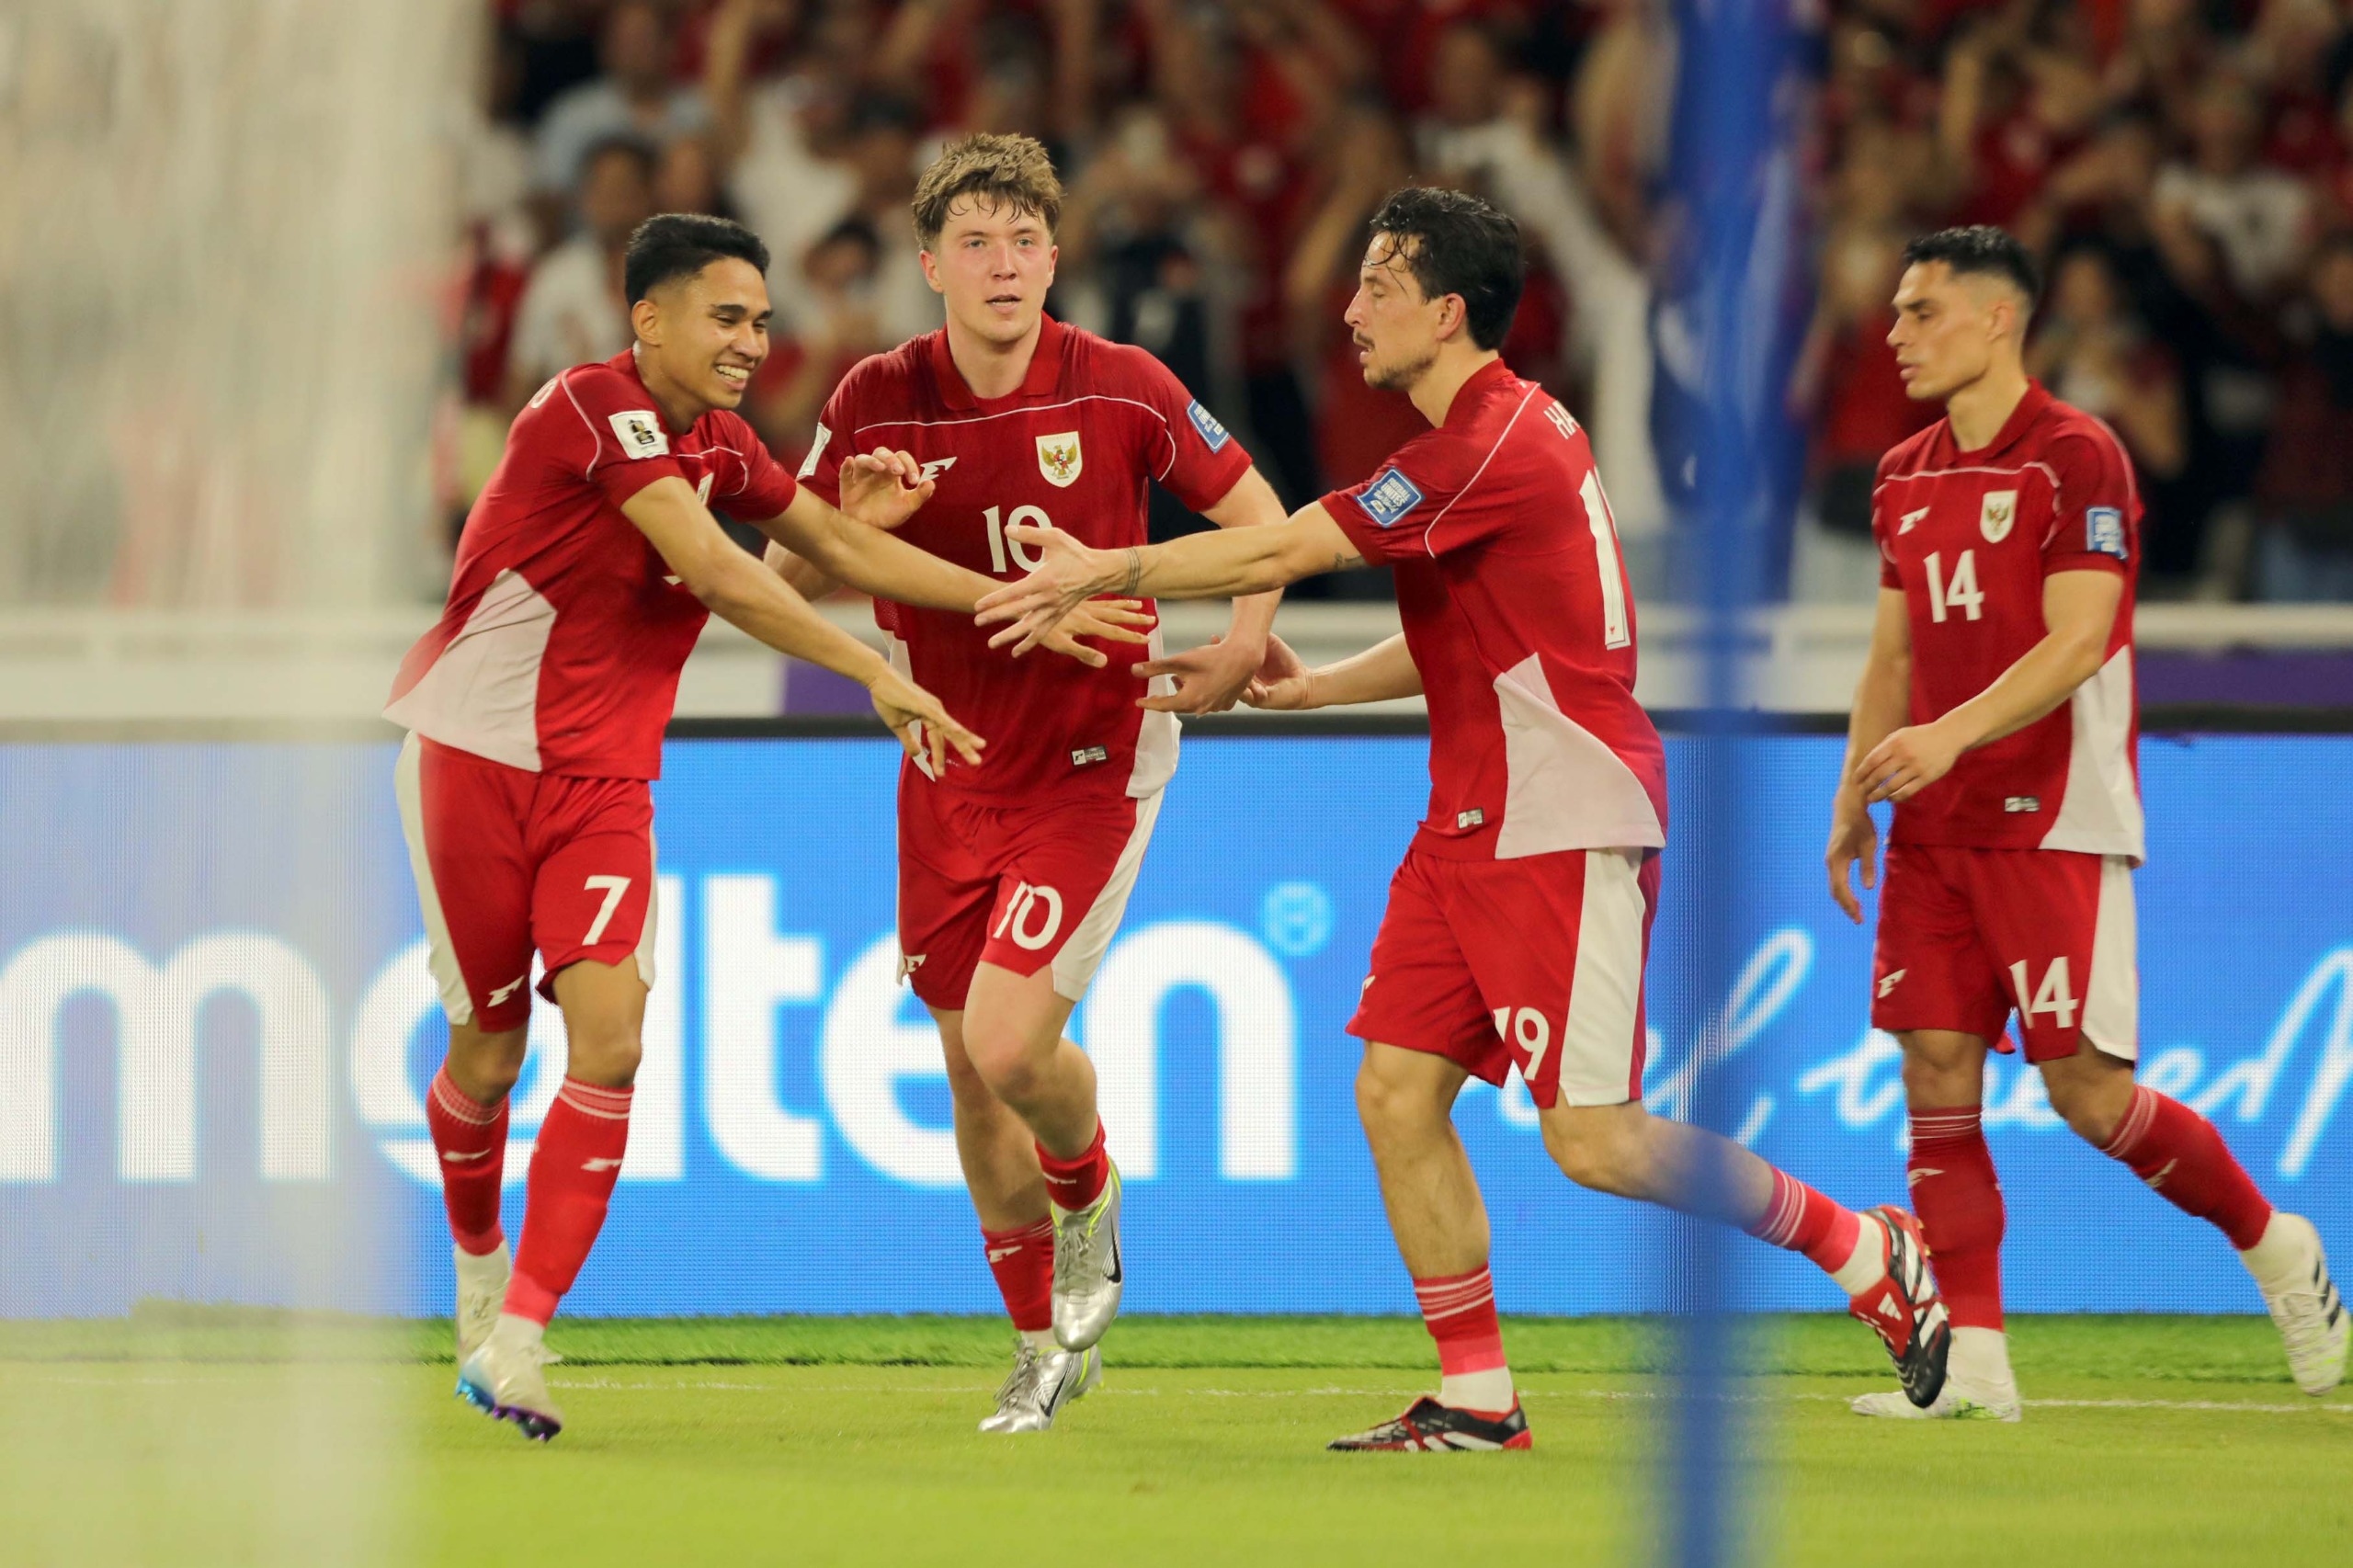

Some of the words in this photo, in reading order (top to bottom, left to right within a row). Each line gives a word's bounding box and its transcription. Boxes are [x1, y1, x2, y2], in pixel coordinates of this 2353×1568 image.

[1578, 465, 1631, 651] 1
[1923, 549, 1985, 624] 14
[582, 874, 632, 946] 7
[992, 880, 1064, 951] 10
[2008, 955, 2079, 1029] 14
